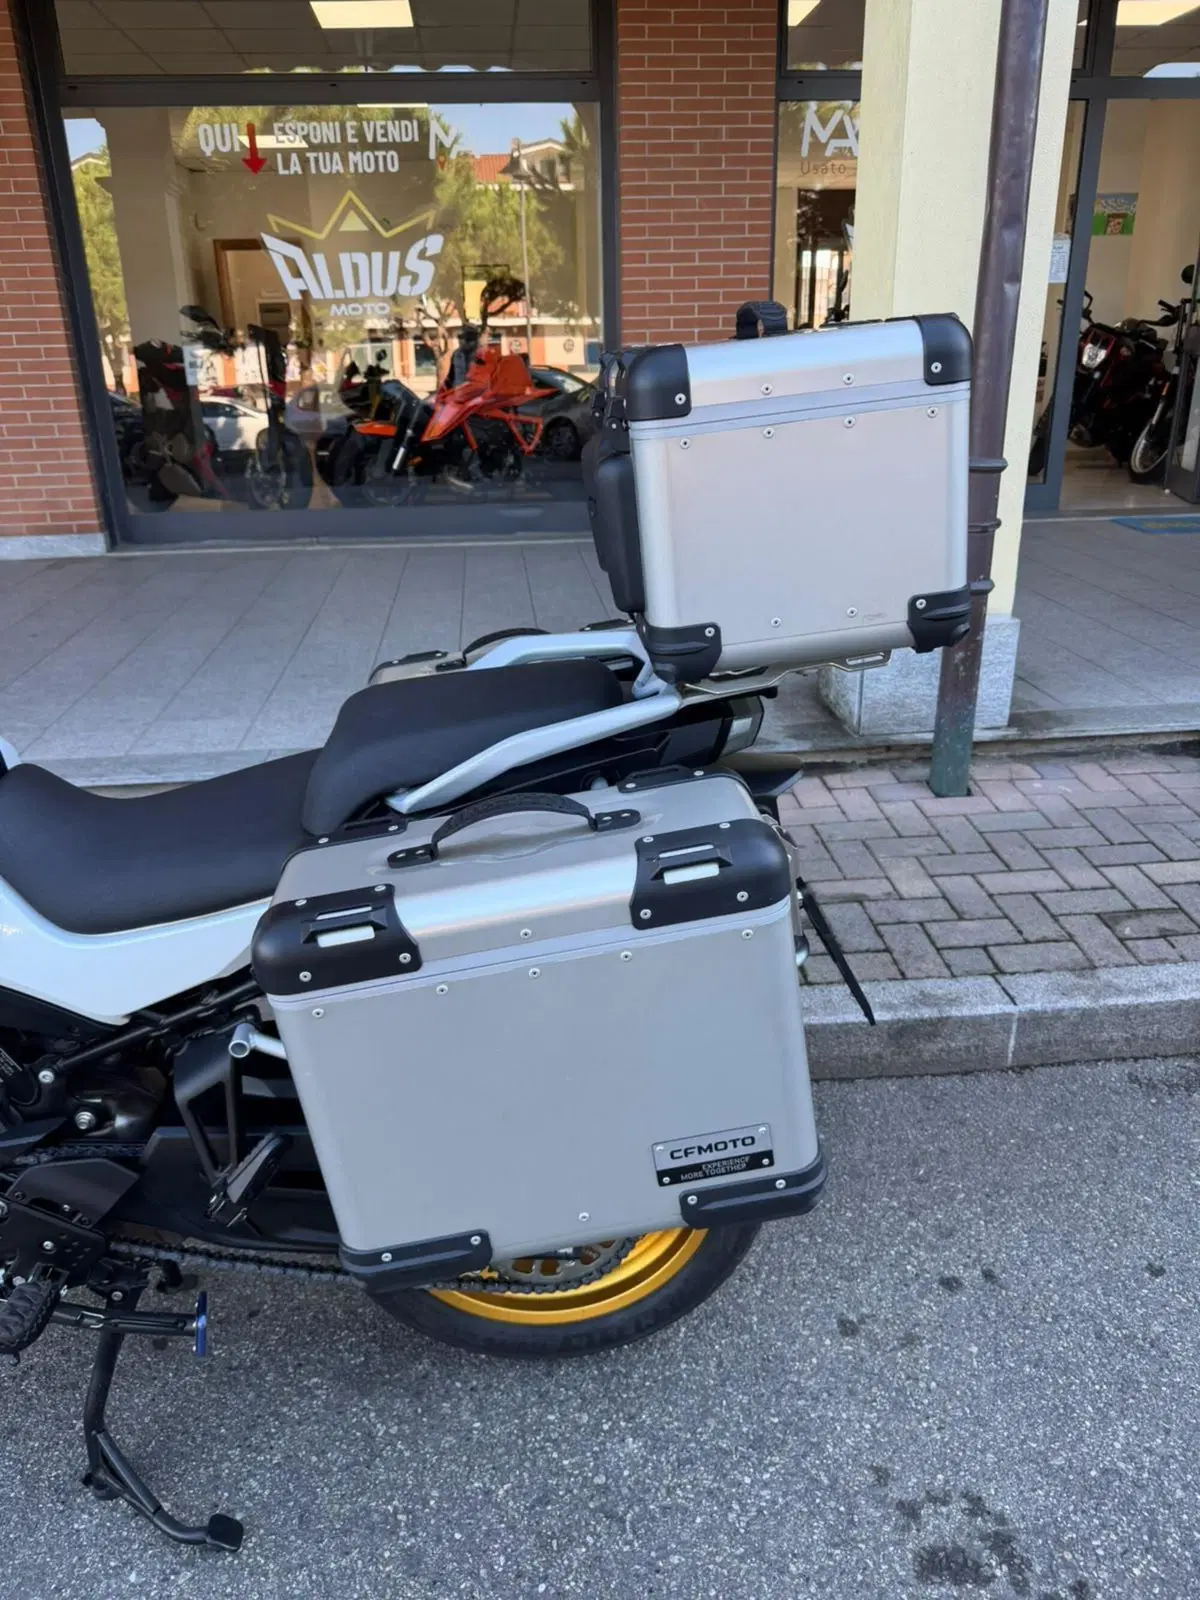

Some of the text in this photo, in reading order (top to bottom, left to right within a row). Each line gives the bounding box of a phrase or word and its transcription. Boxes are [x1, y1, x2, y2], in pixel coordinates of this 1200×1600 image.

[198, 123, 241, 157] QUI
[274, 119, 419, 144] ESPONI E VENDI
[276, 150, 399, 176] LA TUA MOTO
[800, 161, 847, 175] Usato
[260, 232, 444, 300] ALDUS
[329, 303, 390, 316] MOTO
[669, 1135, 756, 1160] CFMOTO
[680, 1163, 747, 1181] MORE TOGETHER
[702, 1156, 750, 1170] EXPERIENCE
